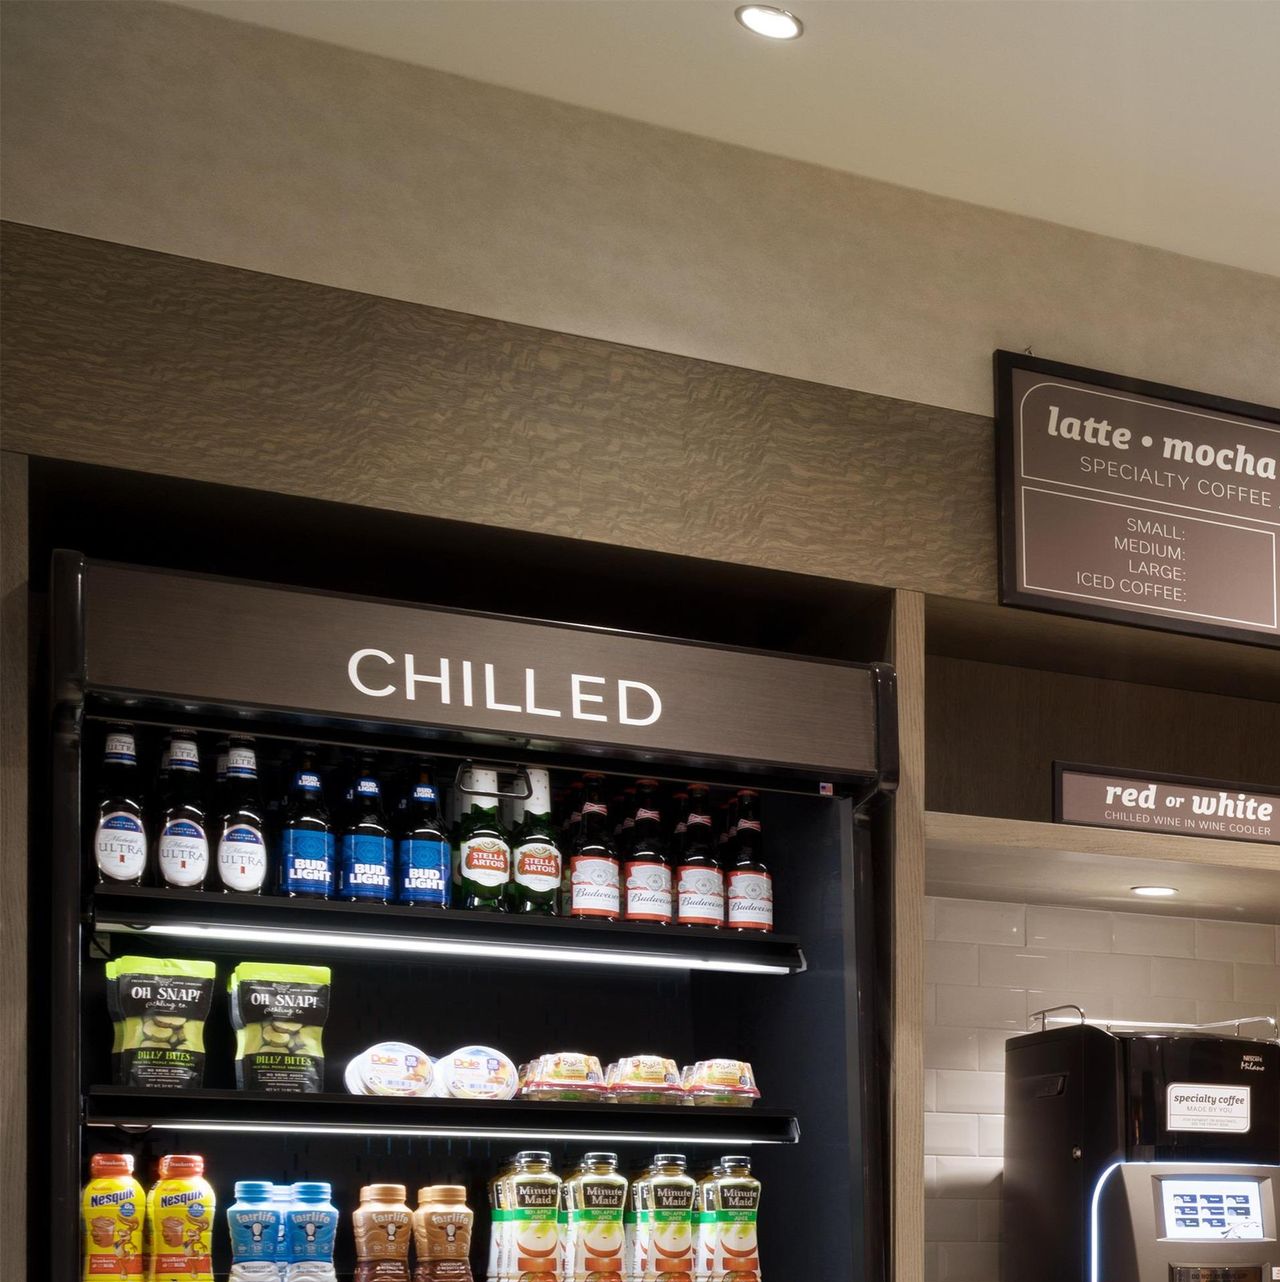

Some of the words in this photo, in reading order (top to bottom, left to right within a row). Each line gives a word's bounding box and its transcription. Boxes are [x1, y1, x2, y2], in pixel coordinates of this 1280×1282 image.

[1047, 406, 1132, 450] latte
[1163, 435, 1277, 480] mocha
[1080, 455, 1191, 491] SPECIALTY
[1197, 479, 1272, 508] COFFEE
[1127, 517, 1186, 541] SMALL:
[1113, 536, 1186, 560] MEDIUM:
[1129, 559, 1186, 581] LARGE:
[1076, 571, 1115, 588] ICED
[1119, 578, 1186, 602] COFFEE:
[348, 648, 662, 726] CHILLED
[1105, 784, 1157, 809] red
[1166, 794, 1184, 808] or
[1192, 792, 1272, 821] white
[1105, 811, 1150, 823] CHILLED
[1153, 816, 1181, 827] WINE
[1185, 818, 1195, 828] IN
[1199, 819, 1226, 832] WINE
[1229, 823, 1271, 836] COOLER
[99, 843, 144, 856] ULTRA
[161, 849, 205, 861] ULTRA
[221, 855, 264, 866] ULTRA
[472, 852, 504, 861] STELLA
[524, 857, 556, 867] STELLA
[295, 859, 327, 870] BUD
[472, 859, 504, 868] ARTOIS
[524, 865, 556, 873] ARTOIS
[290, 869, 331, 881] LIGHT
[355, 864, 385, 875] BUD
[409, 869, 439, 879] BUD
[350, 873, 390, 886] LIGHT
[405, 878, 445, 890] LIGHT
[131, 987, 150, 999] OH
[157, 987, 201, 1002] SNAP!
[251, 993, 269, 1005] OH
[275, 995, 317, 1008] SNAP!
[138, 1051, 162, 1059] DILLY
[256, 1056, 281, 1064] DILLY
[284, 1057, 311, 1065] BITES
[371, 1054, 399, 1065] Dole
[1241, 1062, 1264, 1071] Milano
[1174, 1094, 1217, 1105] specialty
[1219, 1096, 1245, 1106] coffee
[519, 1185, 556, 1195] Minute
[586, 1186, 623, 1196] Minute
[657, 1187, 691, 1198] Minute
[723, 1188, 757, 1198] Minute
[91, 1189, 135, 1207] Nesquik
[160, 1190, 203, 1207] Nesquik
[525, 1194, 551, 1204] Maid
[592, 1195, 619, 1205] Maid
[662, 1197, 687, 1206] Maid
[728, 1197, 753, 1206] Maid
[235, 1213, 276, 1224] fairlife
[291, 1212, 330, 1223] fairlife
[372, 1213, 409, 1224] fairlife
[432, 1214, 468, 1224] fairlife
